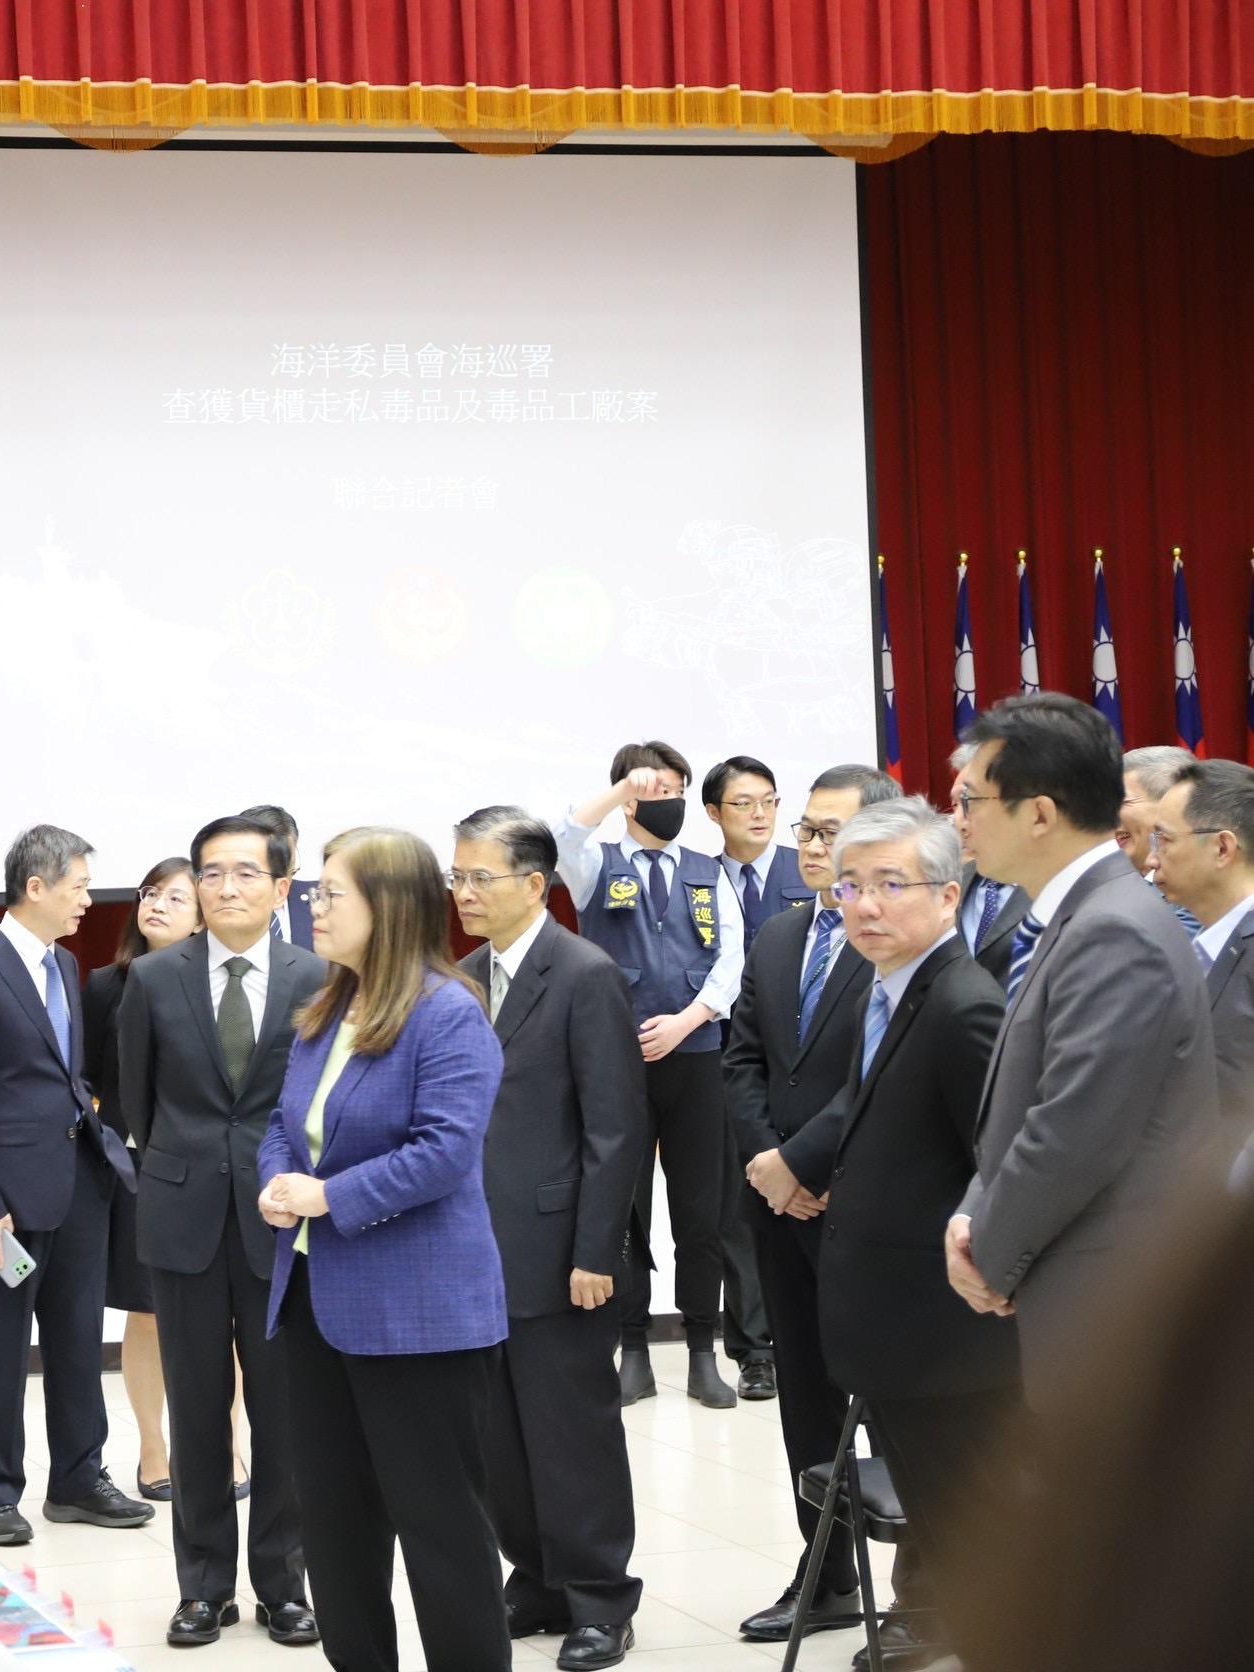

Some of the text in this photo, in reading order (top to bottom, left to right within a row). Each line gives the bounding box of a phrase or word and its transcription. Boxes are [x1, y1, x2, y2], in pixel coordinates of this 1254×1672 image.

[270, 342, 554, 379] 海洋委員會海巡署
[160, 388, 659, 426] 查獲貨櫃走私毒品及毒品工廠案
[331, 475, 500, 512] 聯合記者會
